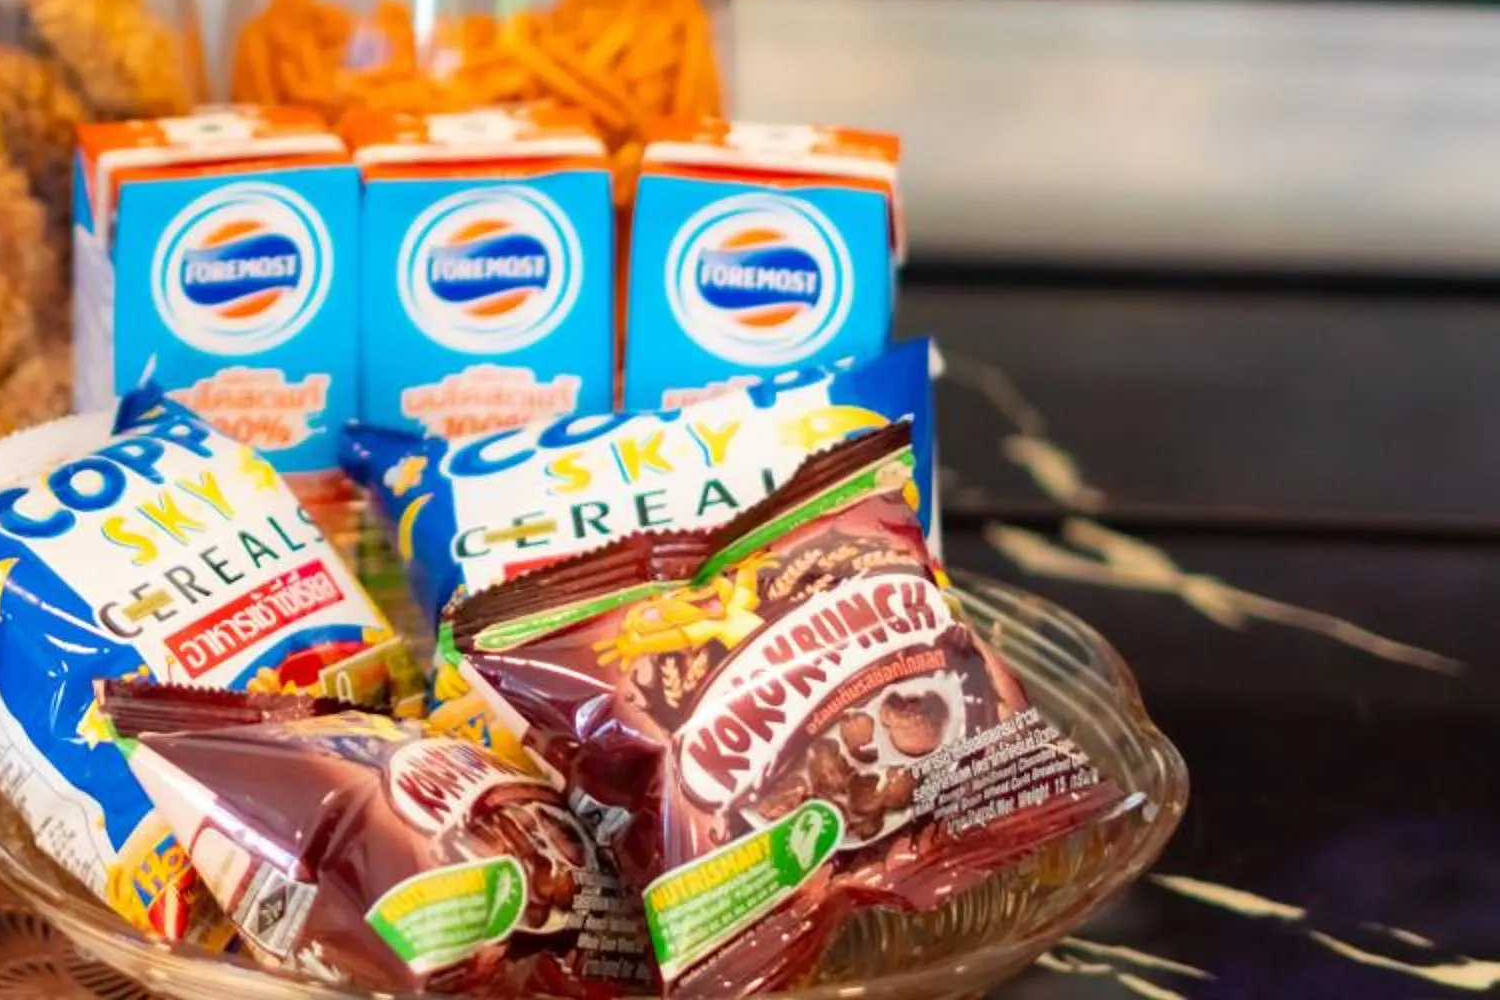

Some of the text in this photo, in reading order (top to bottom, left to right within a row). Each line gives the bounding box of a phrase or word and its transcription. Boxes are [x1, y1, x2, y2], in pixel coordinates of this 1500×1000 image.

[185, 255, 297, 285] FOREMOST
[430, 255, 545, 282] FOREMOST
[701, 263, 817, 295] FOREMOST
[546, 419, 740, 494] SKY
[102, 471, 236, 565] SKY
[456, 468, 778, 558] CEREA
